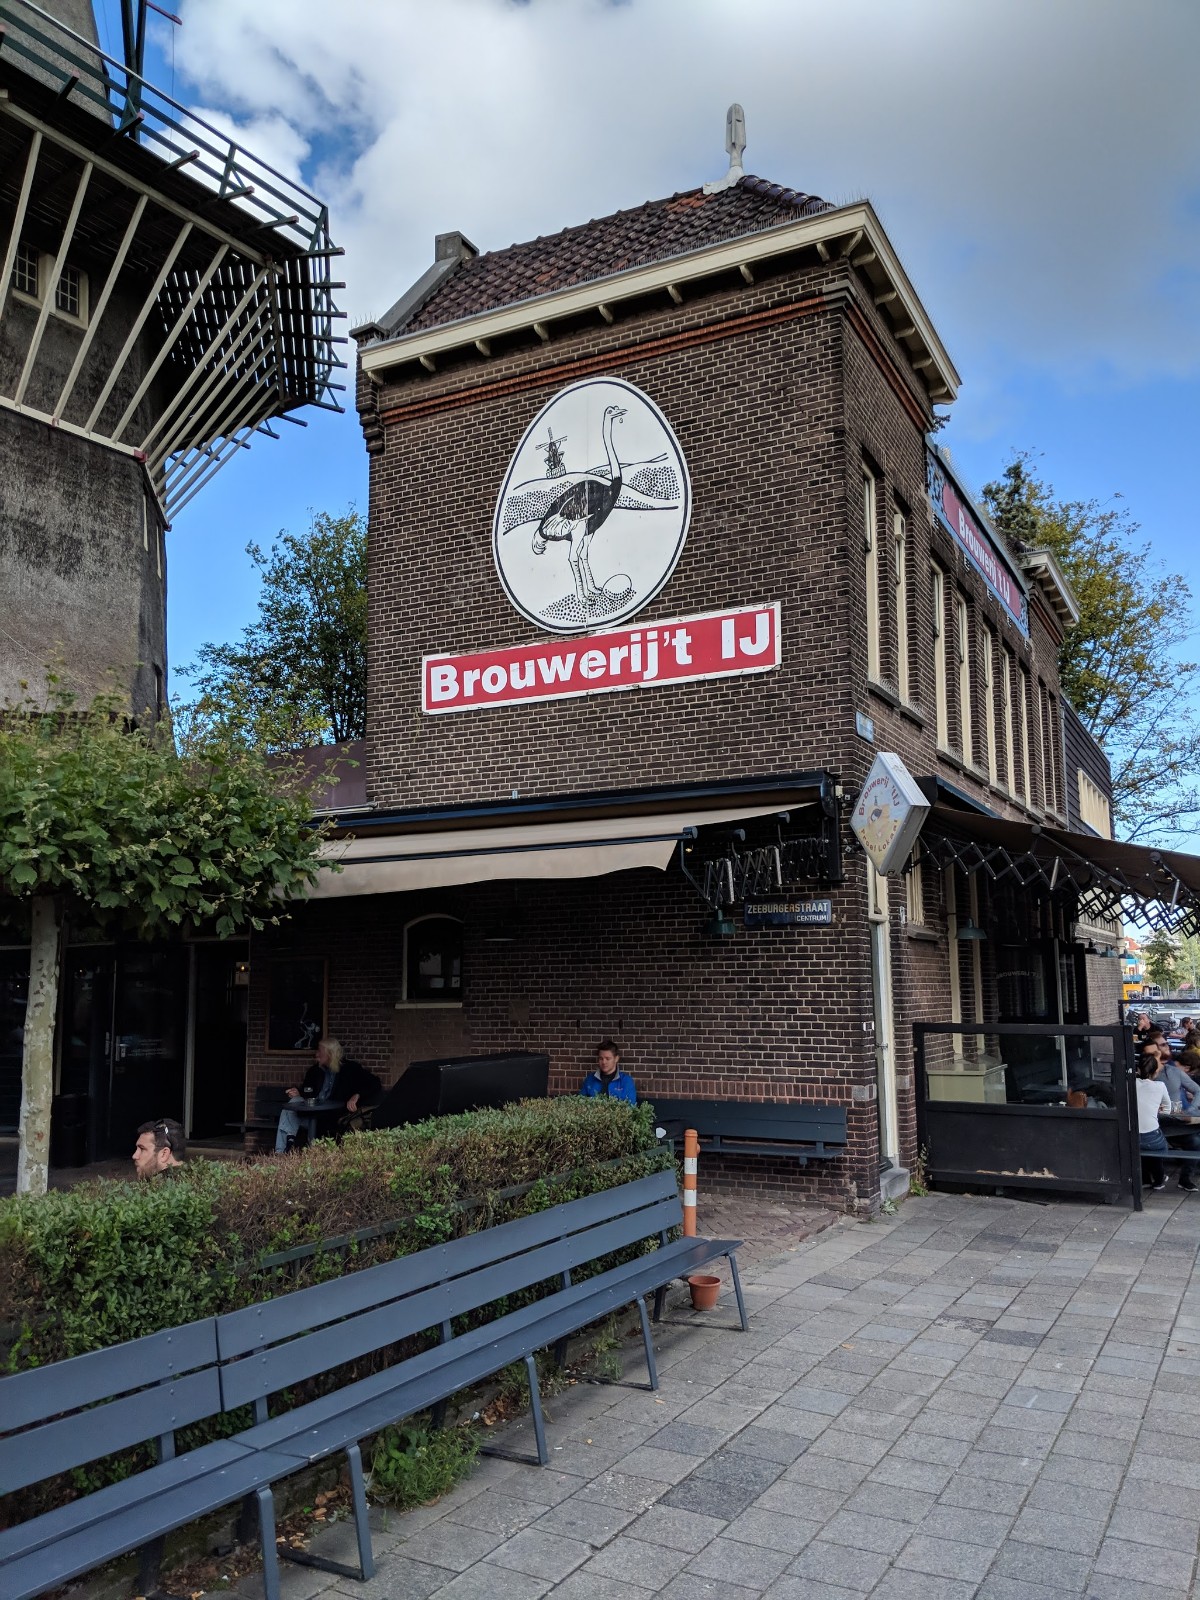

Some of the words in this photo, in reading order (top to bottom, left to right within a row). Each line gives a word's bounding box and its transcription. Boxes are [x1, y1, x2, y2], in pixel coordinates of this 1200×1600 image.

[958, 508, 997, 589] Brouwerij
[720, 611, 771, 660] IJ
[859, 776, 889, 816] Brouwerij
[747, 902, 829, 914] ZEEBURGERSTRAAT
[796, 914, 827, 922] CENTRUM
